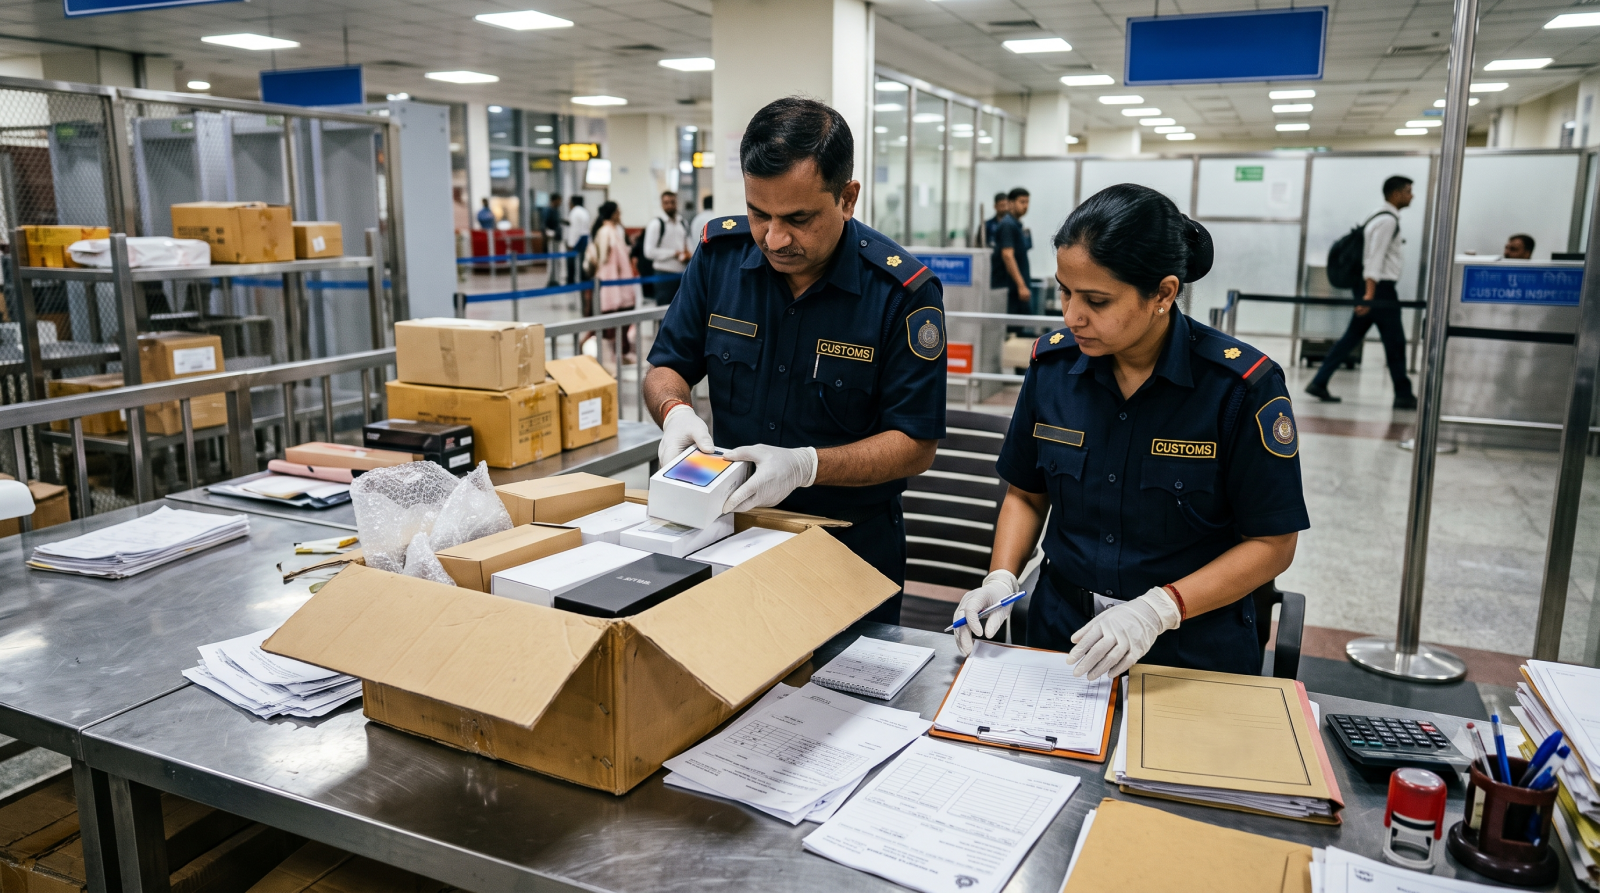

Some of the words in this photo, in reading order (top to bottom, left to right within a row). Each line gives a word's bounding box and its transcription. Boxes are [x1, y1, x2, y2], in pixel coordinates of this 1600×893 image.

[1469, 287, 1522, 299] CUSTOMS
[820, 343, 870, 359] CUSTOMS
[1155, 441, 1212, 455] CUSTOMS
